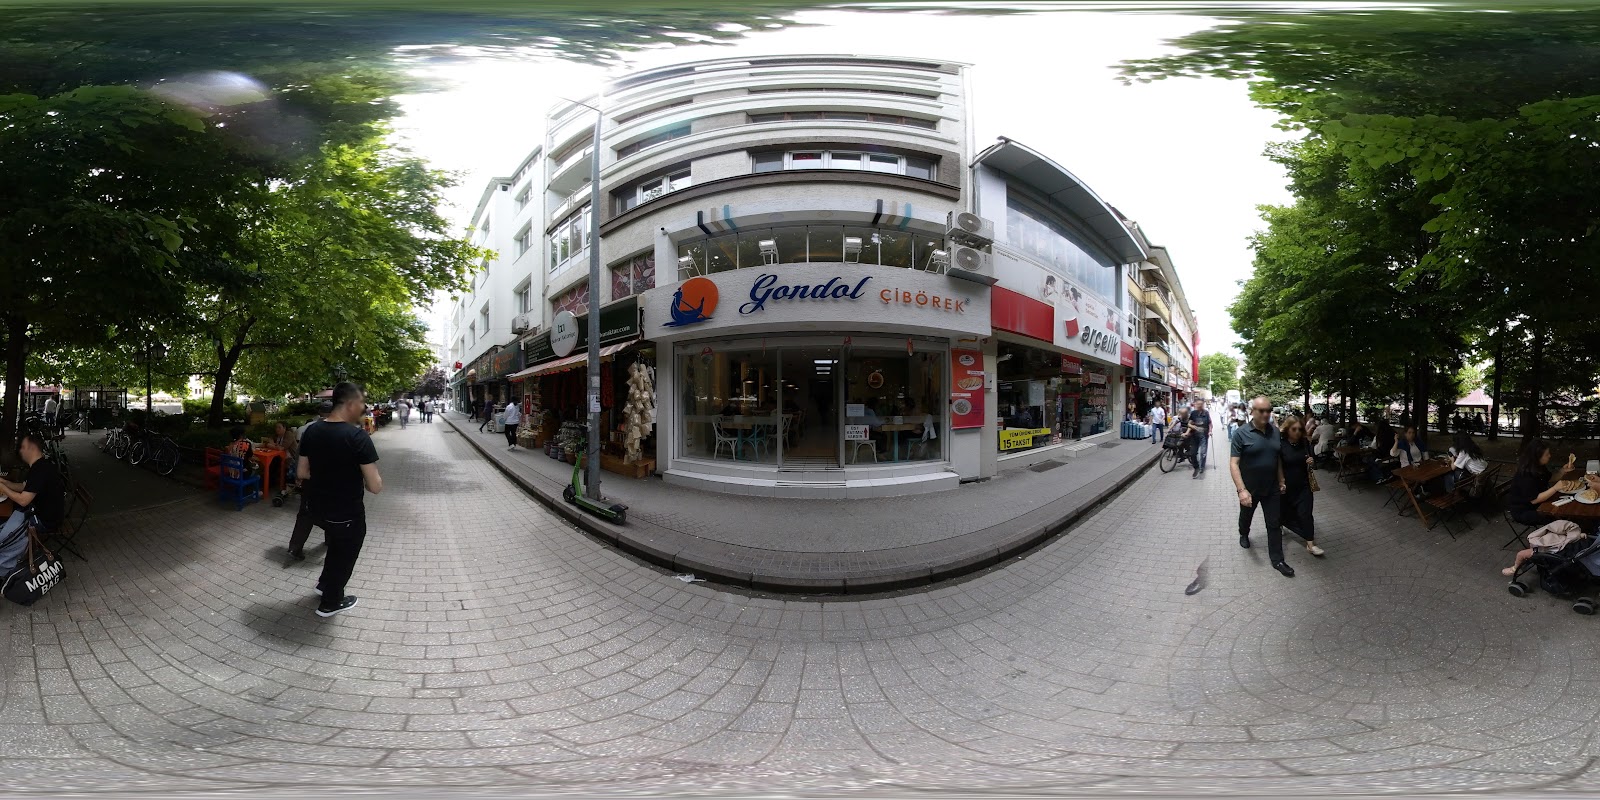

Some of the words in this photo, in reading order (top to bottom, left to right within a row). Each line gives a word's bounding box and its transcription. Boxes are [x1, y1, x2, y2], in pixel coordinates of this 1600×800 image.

[738, 273, 873, 315] Gondol
[879, 287, 966, 314] ÇİBÖREK
[1081, 325, 1119, 356] arçelik
[1003, 439, 1012, 449] 15
[41, 575, 60, 595] BAG
